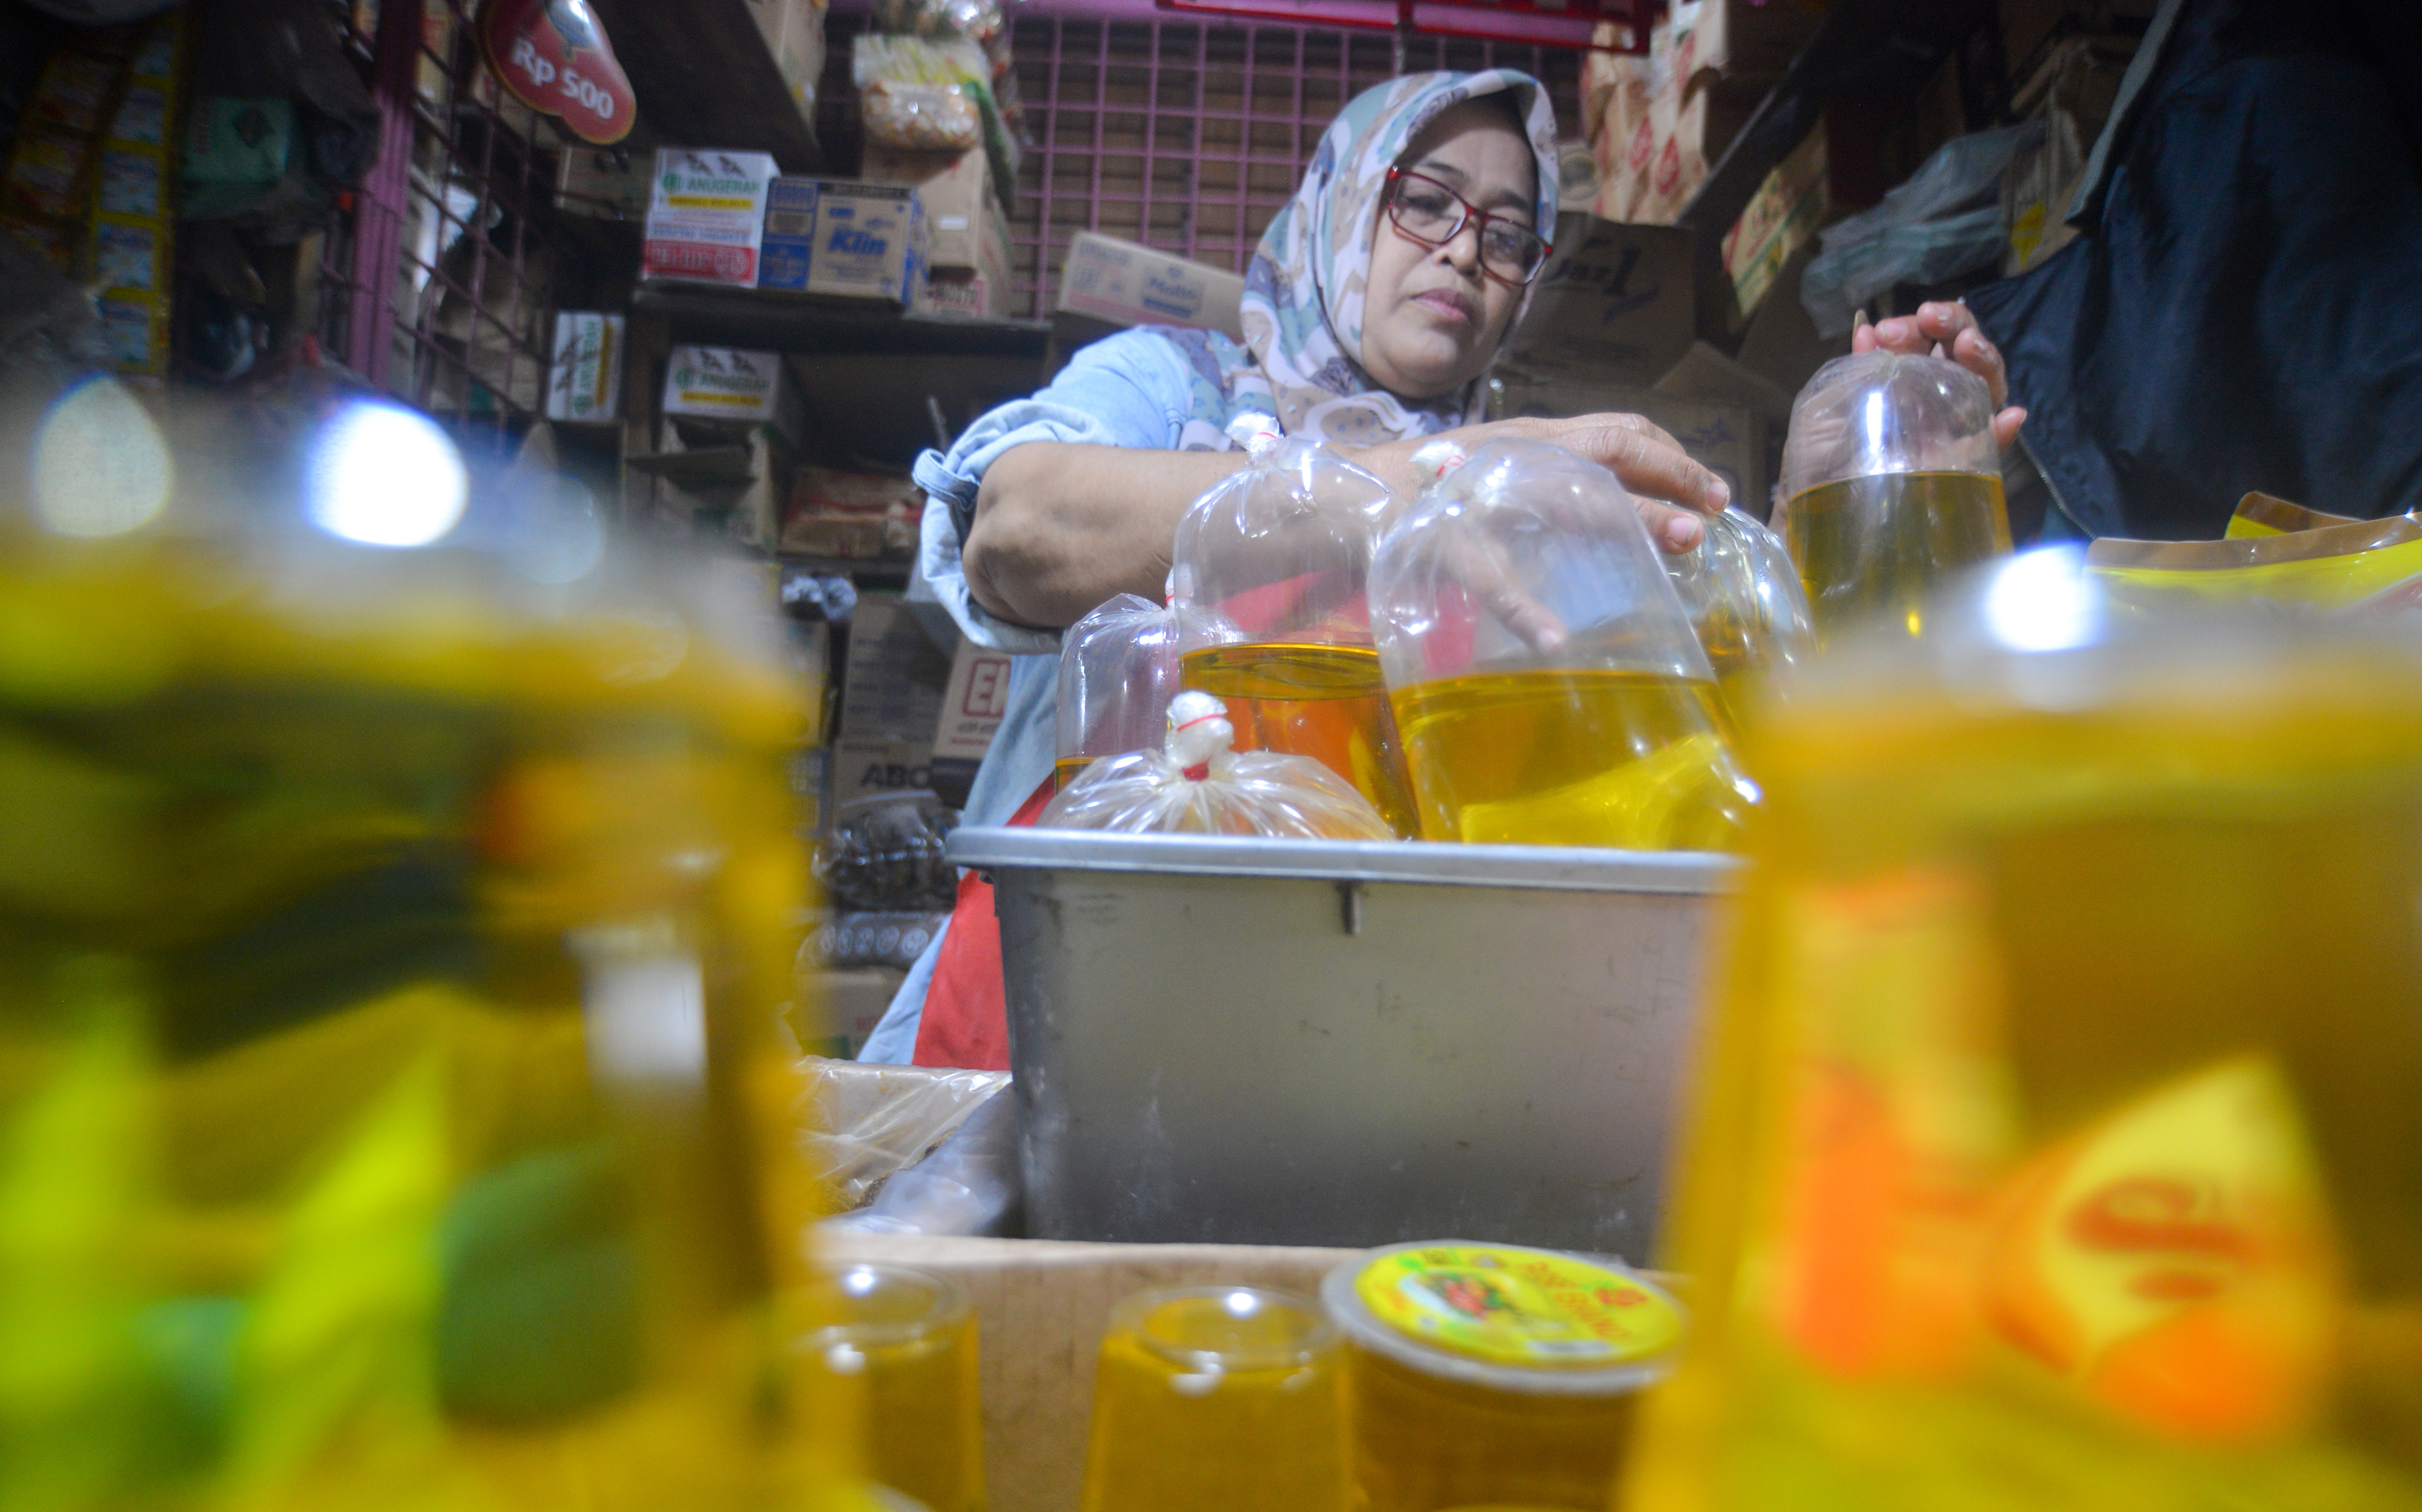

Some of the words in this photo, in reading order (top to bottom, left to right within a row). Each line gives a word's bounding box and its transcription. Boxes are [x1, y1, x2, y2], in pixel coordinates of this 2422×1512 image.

[512, 39, 556, 87] Rp
[560, 68, 614, 119] 500
[828, 228, 888, 256] Klin
